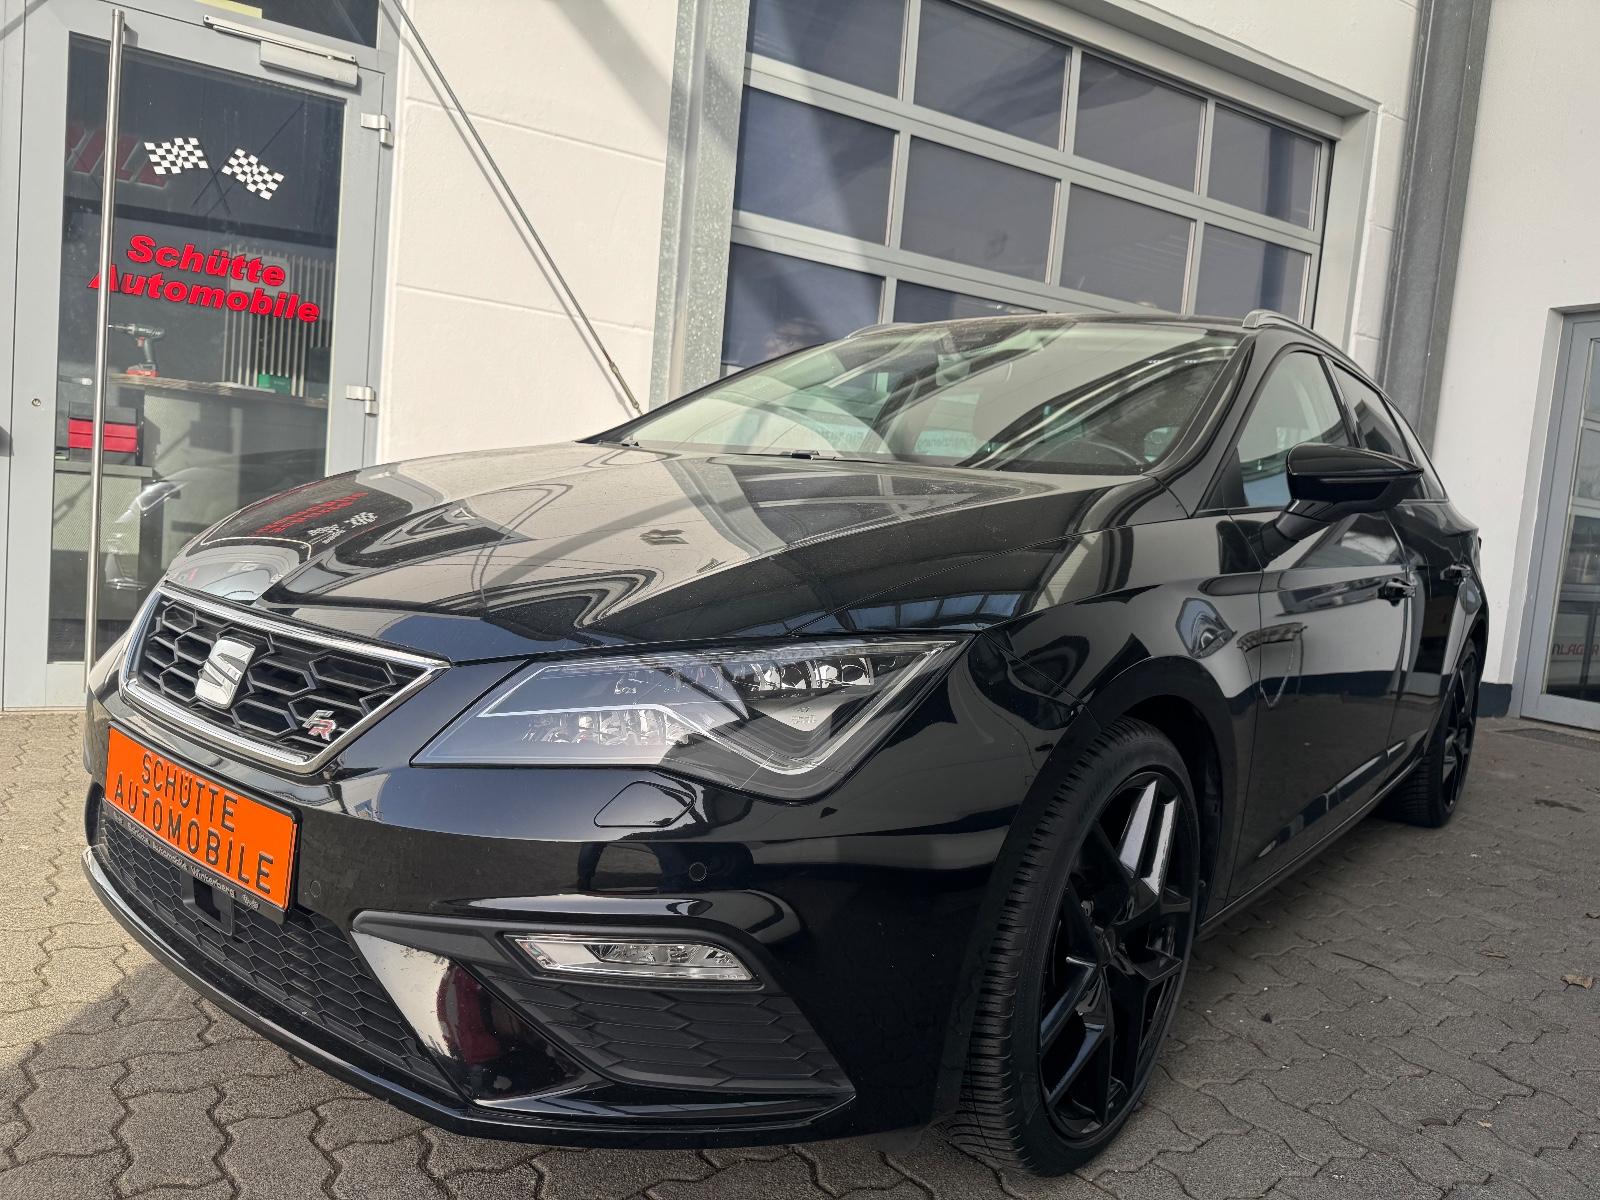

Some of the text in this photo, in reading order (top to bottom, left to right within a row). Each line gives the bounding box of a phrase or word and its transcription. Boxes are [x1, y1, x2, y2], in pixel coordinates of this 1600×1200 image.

[87, 264, 321, 323] Automobile
[127, 234, 286, 287] Schütte
[141, 750, 238, 833] SCHÜTTE
[114, 771, 274, 895] AUTOMOBILE
